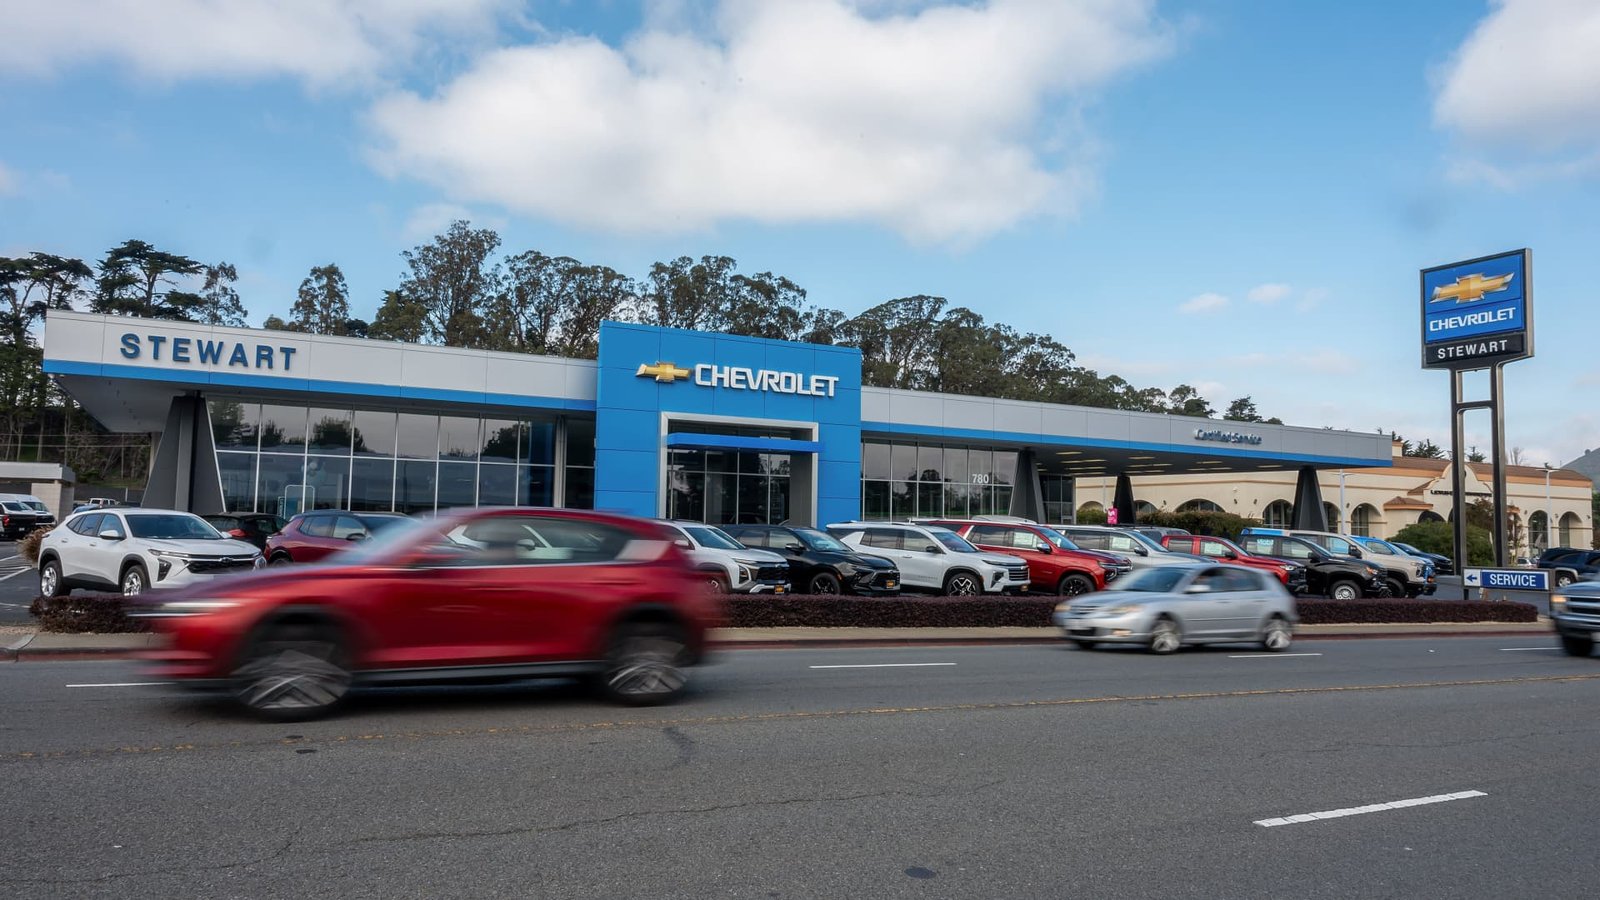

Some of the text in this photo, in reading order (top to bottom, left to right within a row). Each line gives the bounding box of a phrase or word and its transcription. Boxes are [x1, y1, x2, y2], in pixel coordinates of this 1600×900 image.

[1429, 306, 1516, 332] CHEVROLET
[120, 332, 297, 371] STEWART
[1437, 338, 1509, 360] STEWART
[694, 363, 839, 398] CHEVROLET
[972, 473, 989, 485] 780
[1489, 572, 1537, 588] SERVICE
